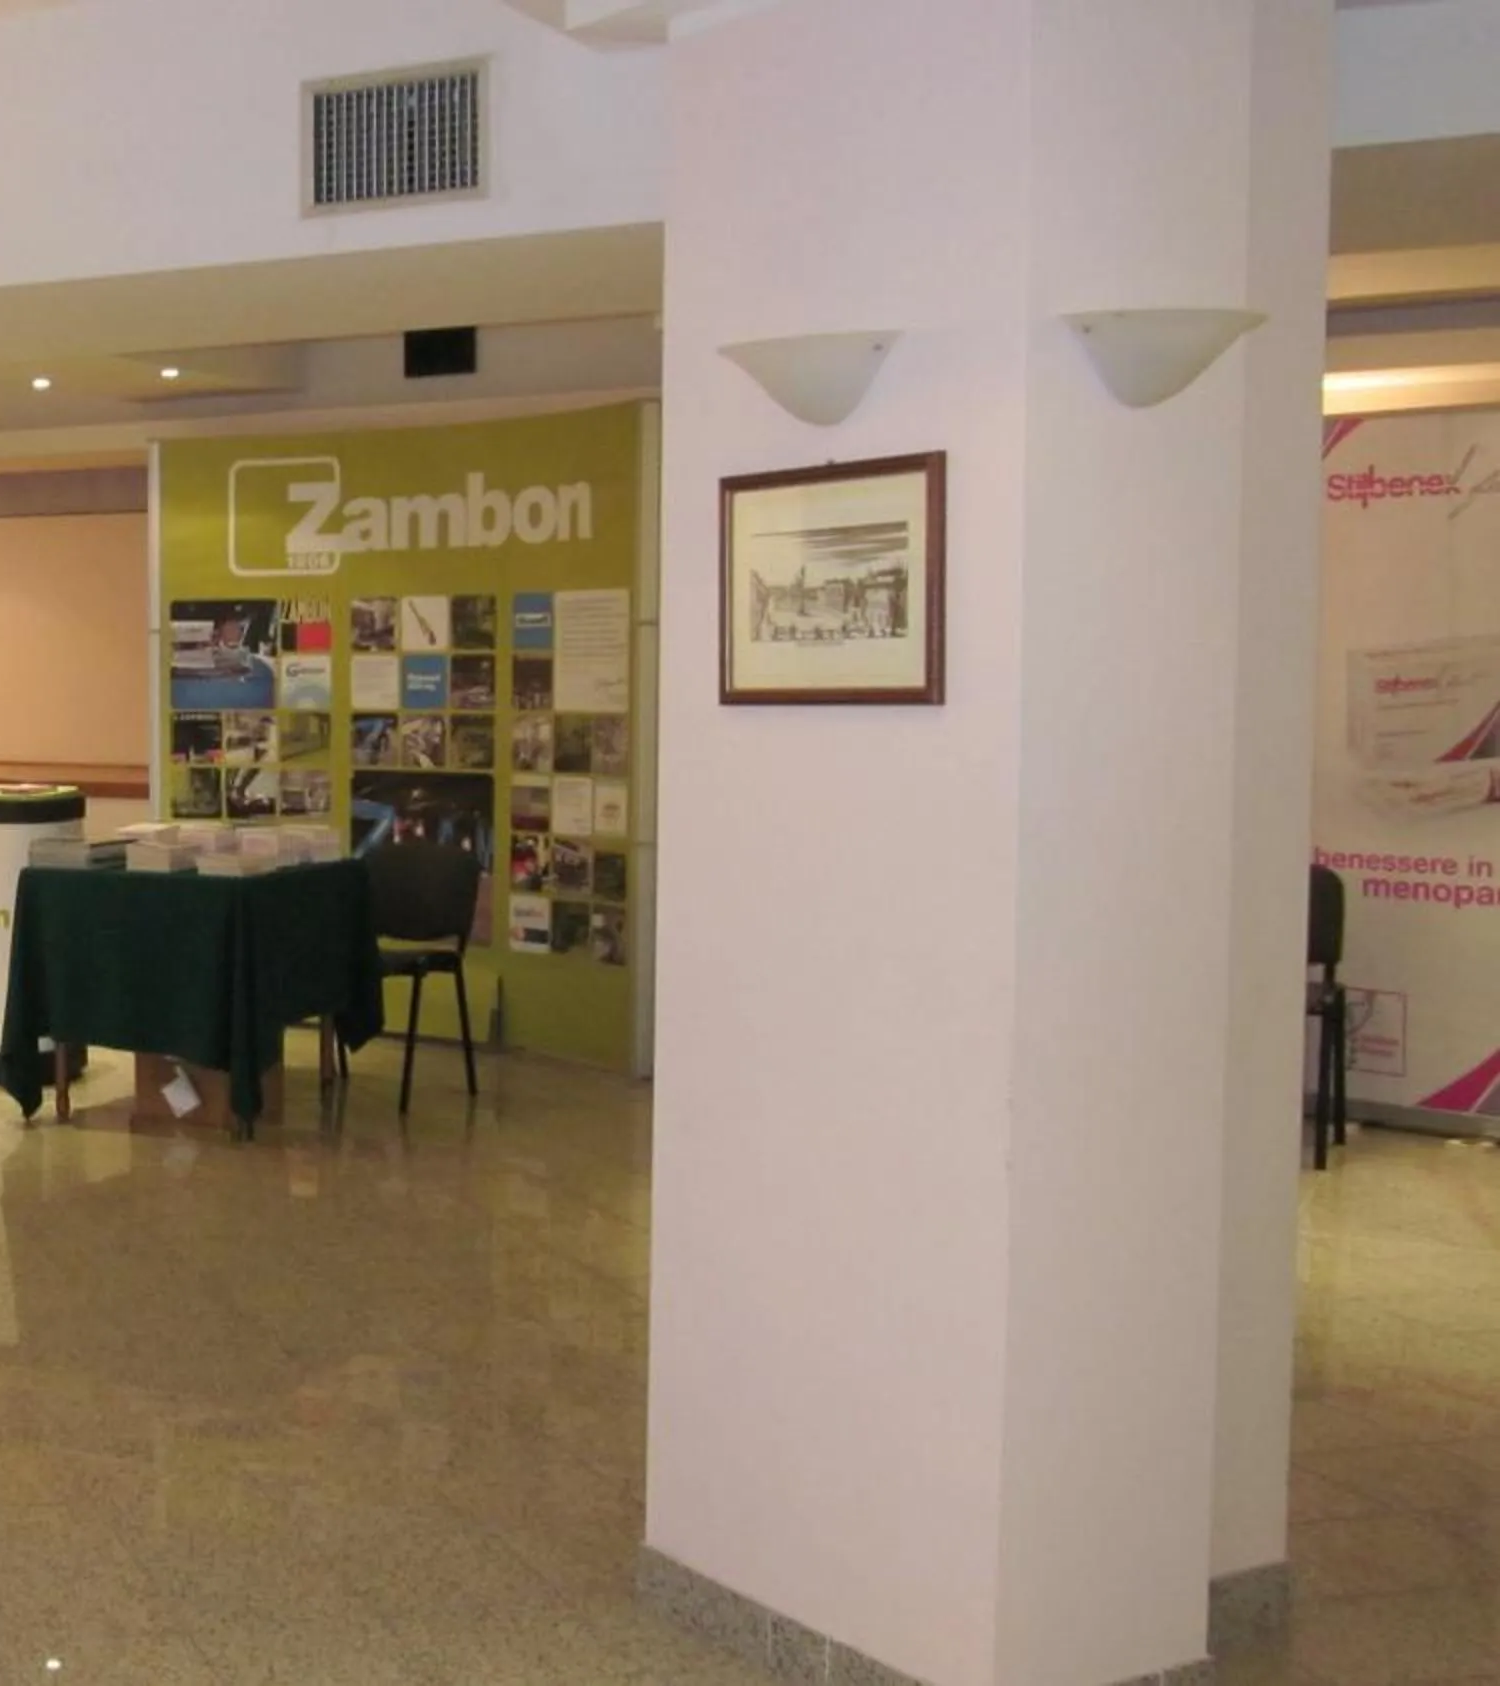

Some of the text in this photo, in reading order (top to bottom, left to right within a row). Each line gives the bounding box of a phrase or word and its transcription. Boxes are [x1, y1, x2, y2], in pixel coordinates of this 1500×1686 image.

[286, 471, 592, 553] Zambon
[1314, 848, 1493, 877] benessere in
